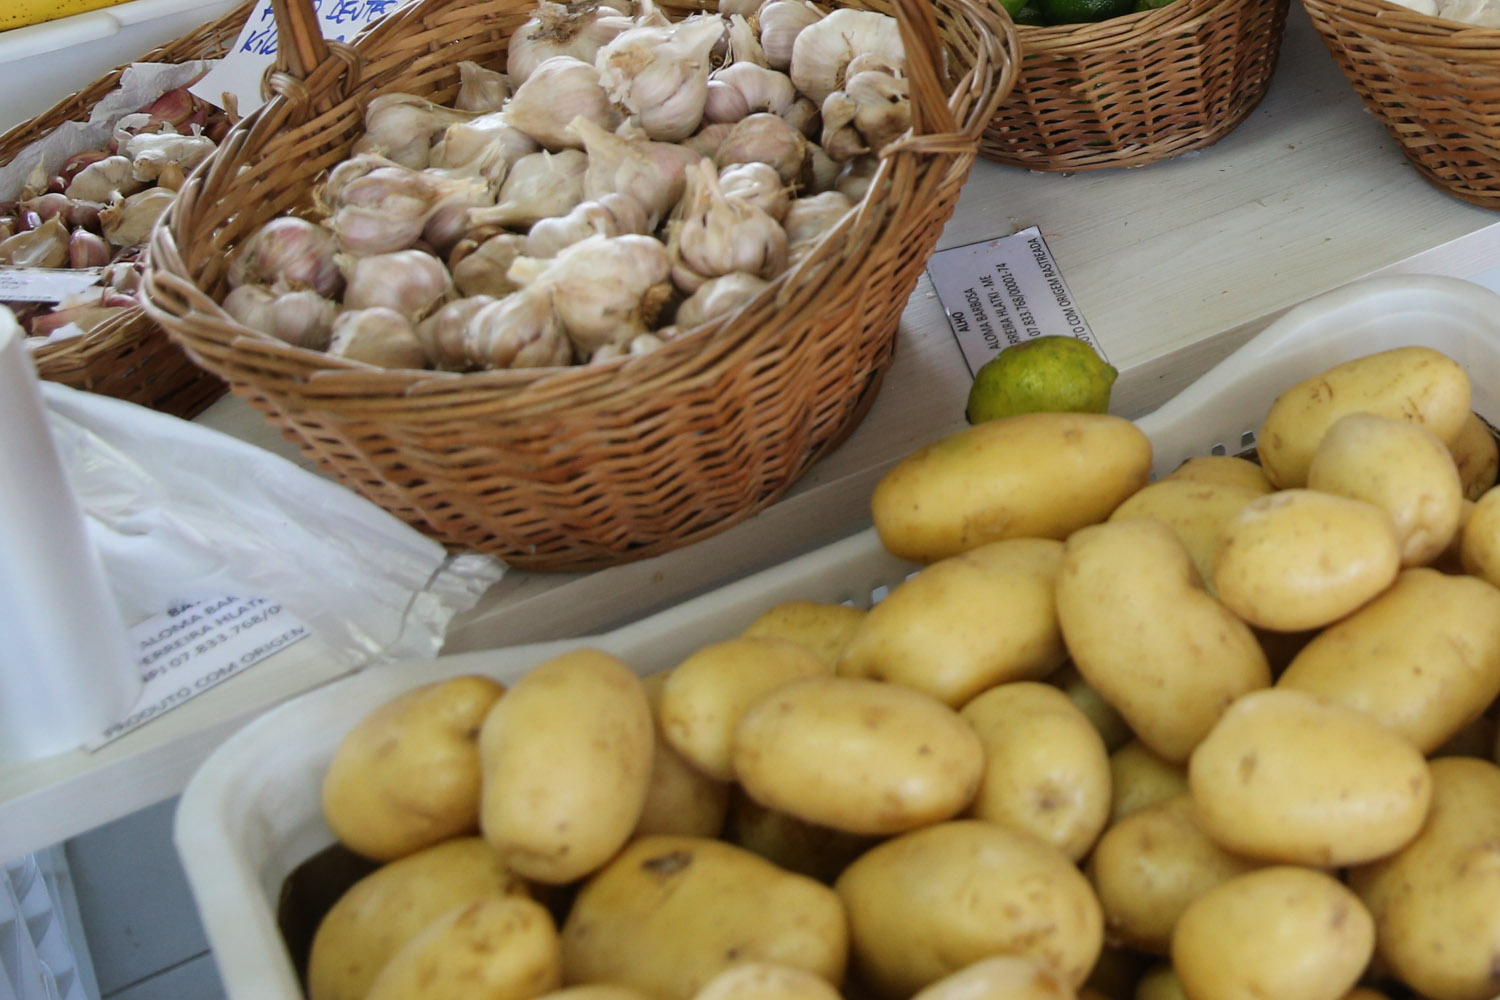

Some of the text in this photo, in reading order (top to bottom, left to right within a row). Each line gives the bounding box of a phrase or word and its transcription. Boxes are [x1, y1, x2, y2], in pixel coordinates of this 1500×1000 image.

[1027, 237, 1055, 278] RASTREADA
[964, 287, 987, 322] BARBOSA
[1047, 275, 1070, 308] ORIGEM
[952, 309, 970, 334] ALHO
[1000, 316, 1021, 345] RREIRA
